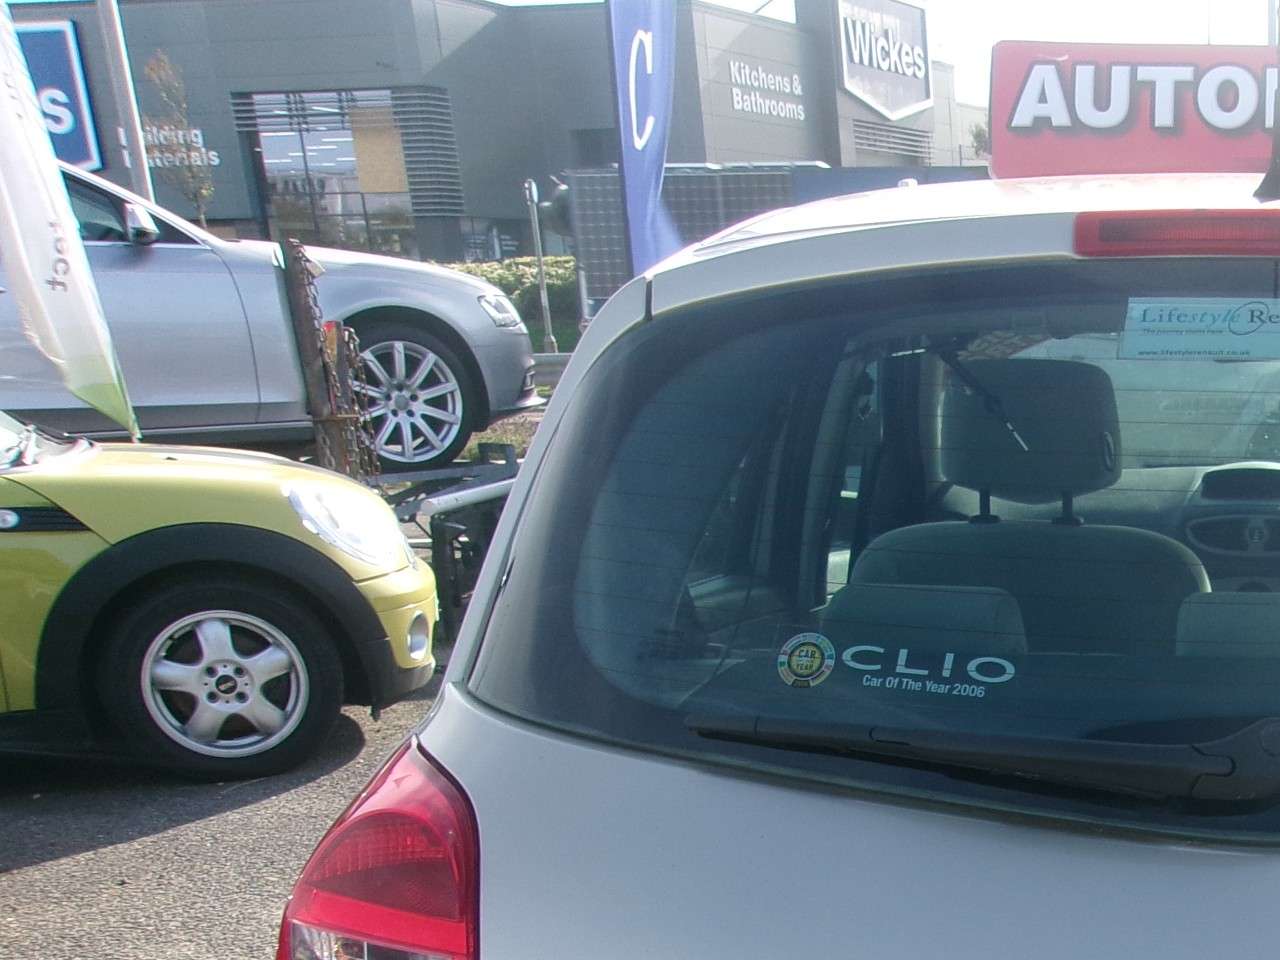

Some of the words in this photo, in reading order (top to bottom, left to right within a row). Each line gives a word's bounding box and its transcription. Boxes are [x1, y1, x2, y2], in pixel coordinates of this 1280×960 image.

[845, 17, 926, 79] Wickes
[730, 60, 791, 93] Kitchens
[792, 74, 803, 96] &
[732, 87, 805, 121] Bathrooms
[1140, 307, 1241, 326] Lifestyle
[798, 649, 816, 659] CAR
[841, 645, 1016, 683] CLIO
[862, 674, 882, 688] Car
[885, 676, 899, 688] Of
[901, 678, 922, 691] The
[925, 680, 950, 695] Year
[952, 683, 986, 698] 2006
